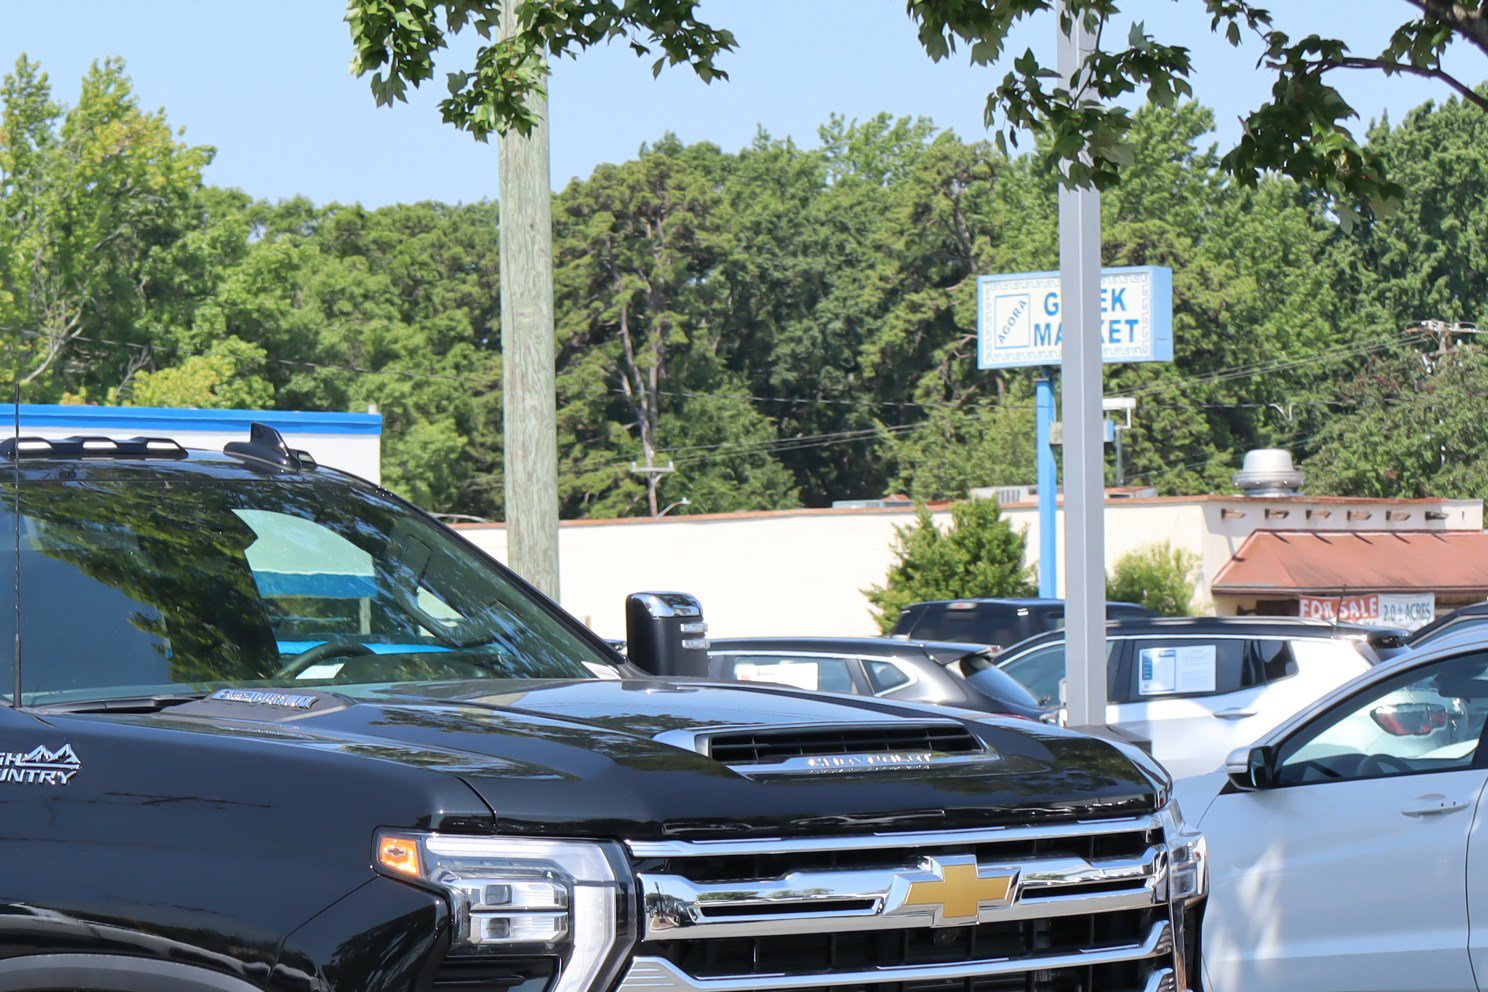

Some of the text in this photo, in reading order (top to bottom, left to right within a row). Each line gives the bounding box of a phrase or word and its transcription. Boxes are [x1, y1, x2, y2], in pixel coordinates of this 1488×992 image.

[999, 300, 1027, 344] AGORA
[1299, 599, 1334, 618] FOR
[1339, 597, 1377, 619] SALE
[1405, 602, 1431, 621] ACRES
